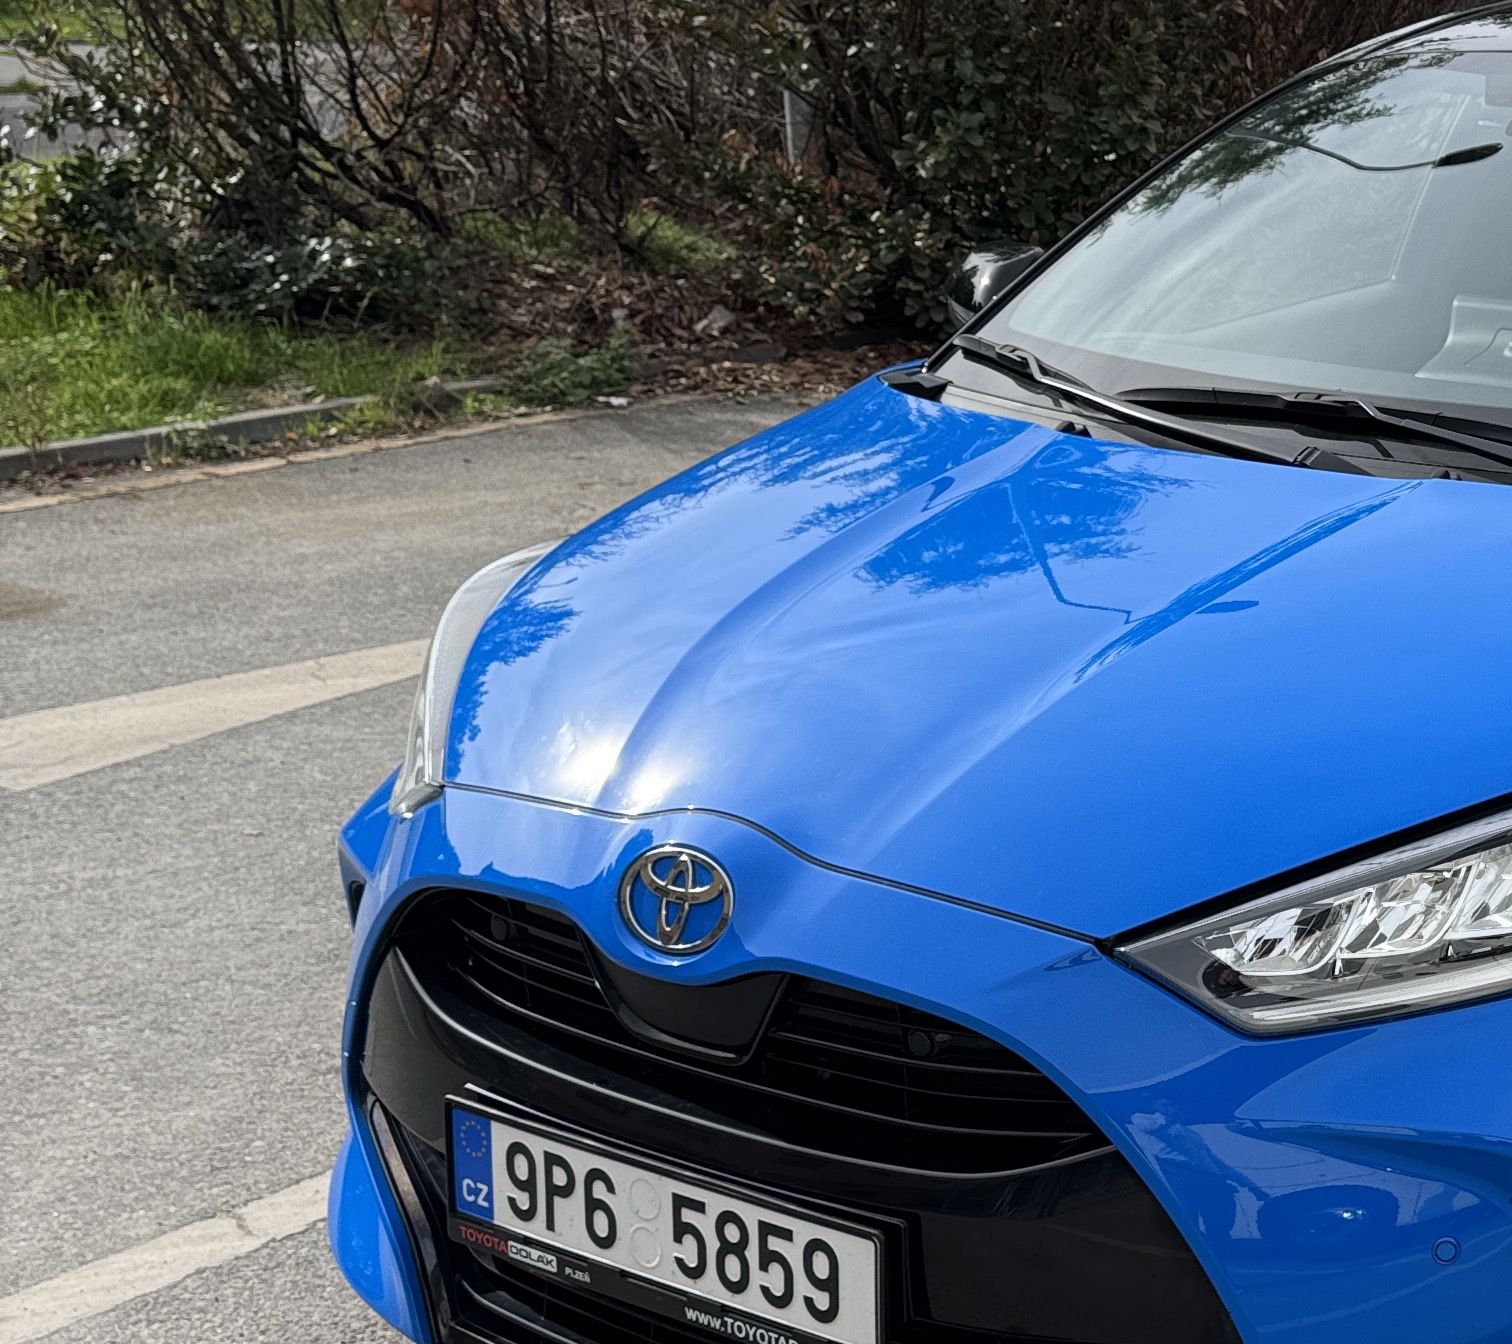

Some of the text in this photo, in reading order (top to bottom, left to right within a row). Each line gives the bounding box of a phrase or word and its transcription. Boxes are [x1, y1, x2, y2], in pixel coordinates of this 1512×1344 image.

[462, 1178, 489, 1208] CZ
[460, 1226, 508, 1254] TOYOTA
[505, 1141, 839, 1324] 9P6 5859
